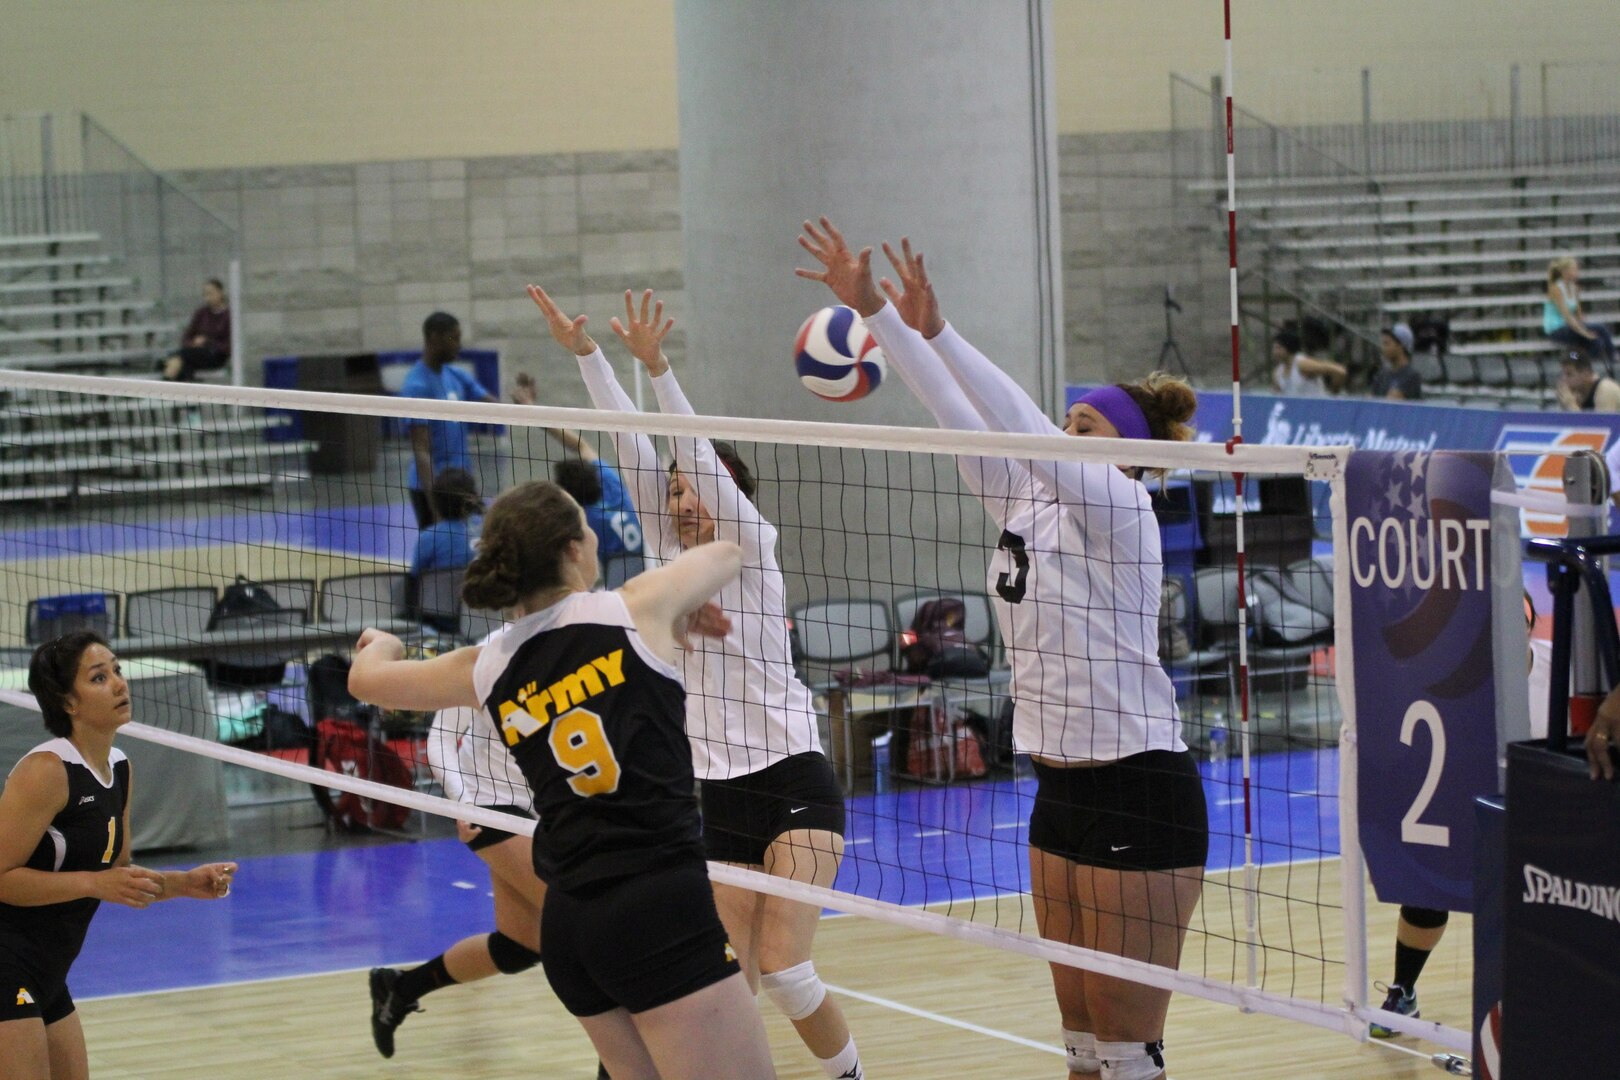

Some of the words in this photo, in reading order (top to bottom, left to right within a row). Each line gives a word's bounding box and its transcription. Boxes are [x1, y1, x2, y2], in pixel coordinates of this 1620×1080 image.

[995, 528, 1030, 605] 3
[1350, 516, 1490, 592] COURT
[548, 707, 622, 798] 9
[1399, 700, 1450, 848] 2
[101, 816, 116, 864] 1
